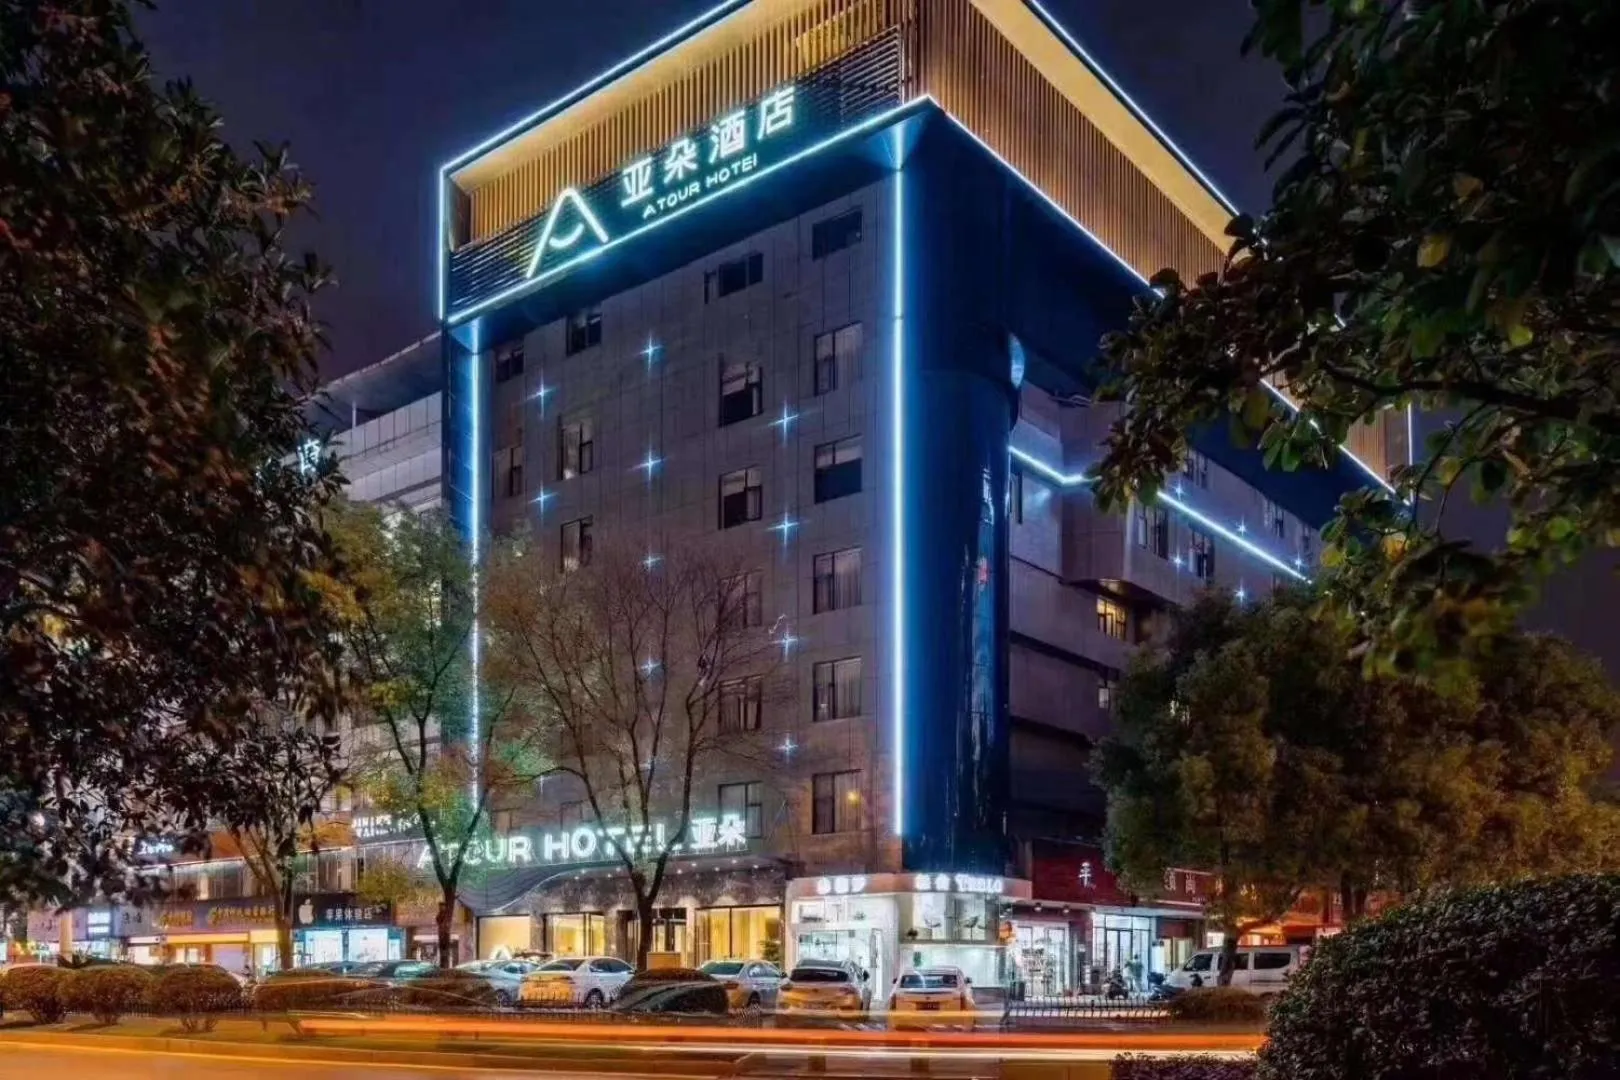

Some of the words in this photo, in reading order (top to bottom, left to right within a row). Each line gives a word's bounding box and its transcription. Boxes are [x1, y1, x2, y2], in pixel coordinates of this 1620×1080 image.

[621, 86, 796, 207] 亚朵酒店
[642, 181, 700, 219] ATOUR
[690, 813, 747, 848] 亚朵
